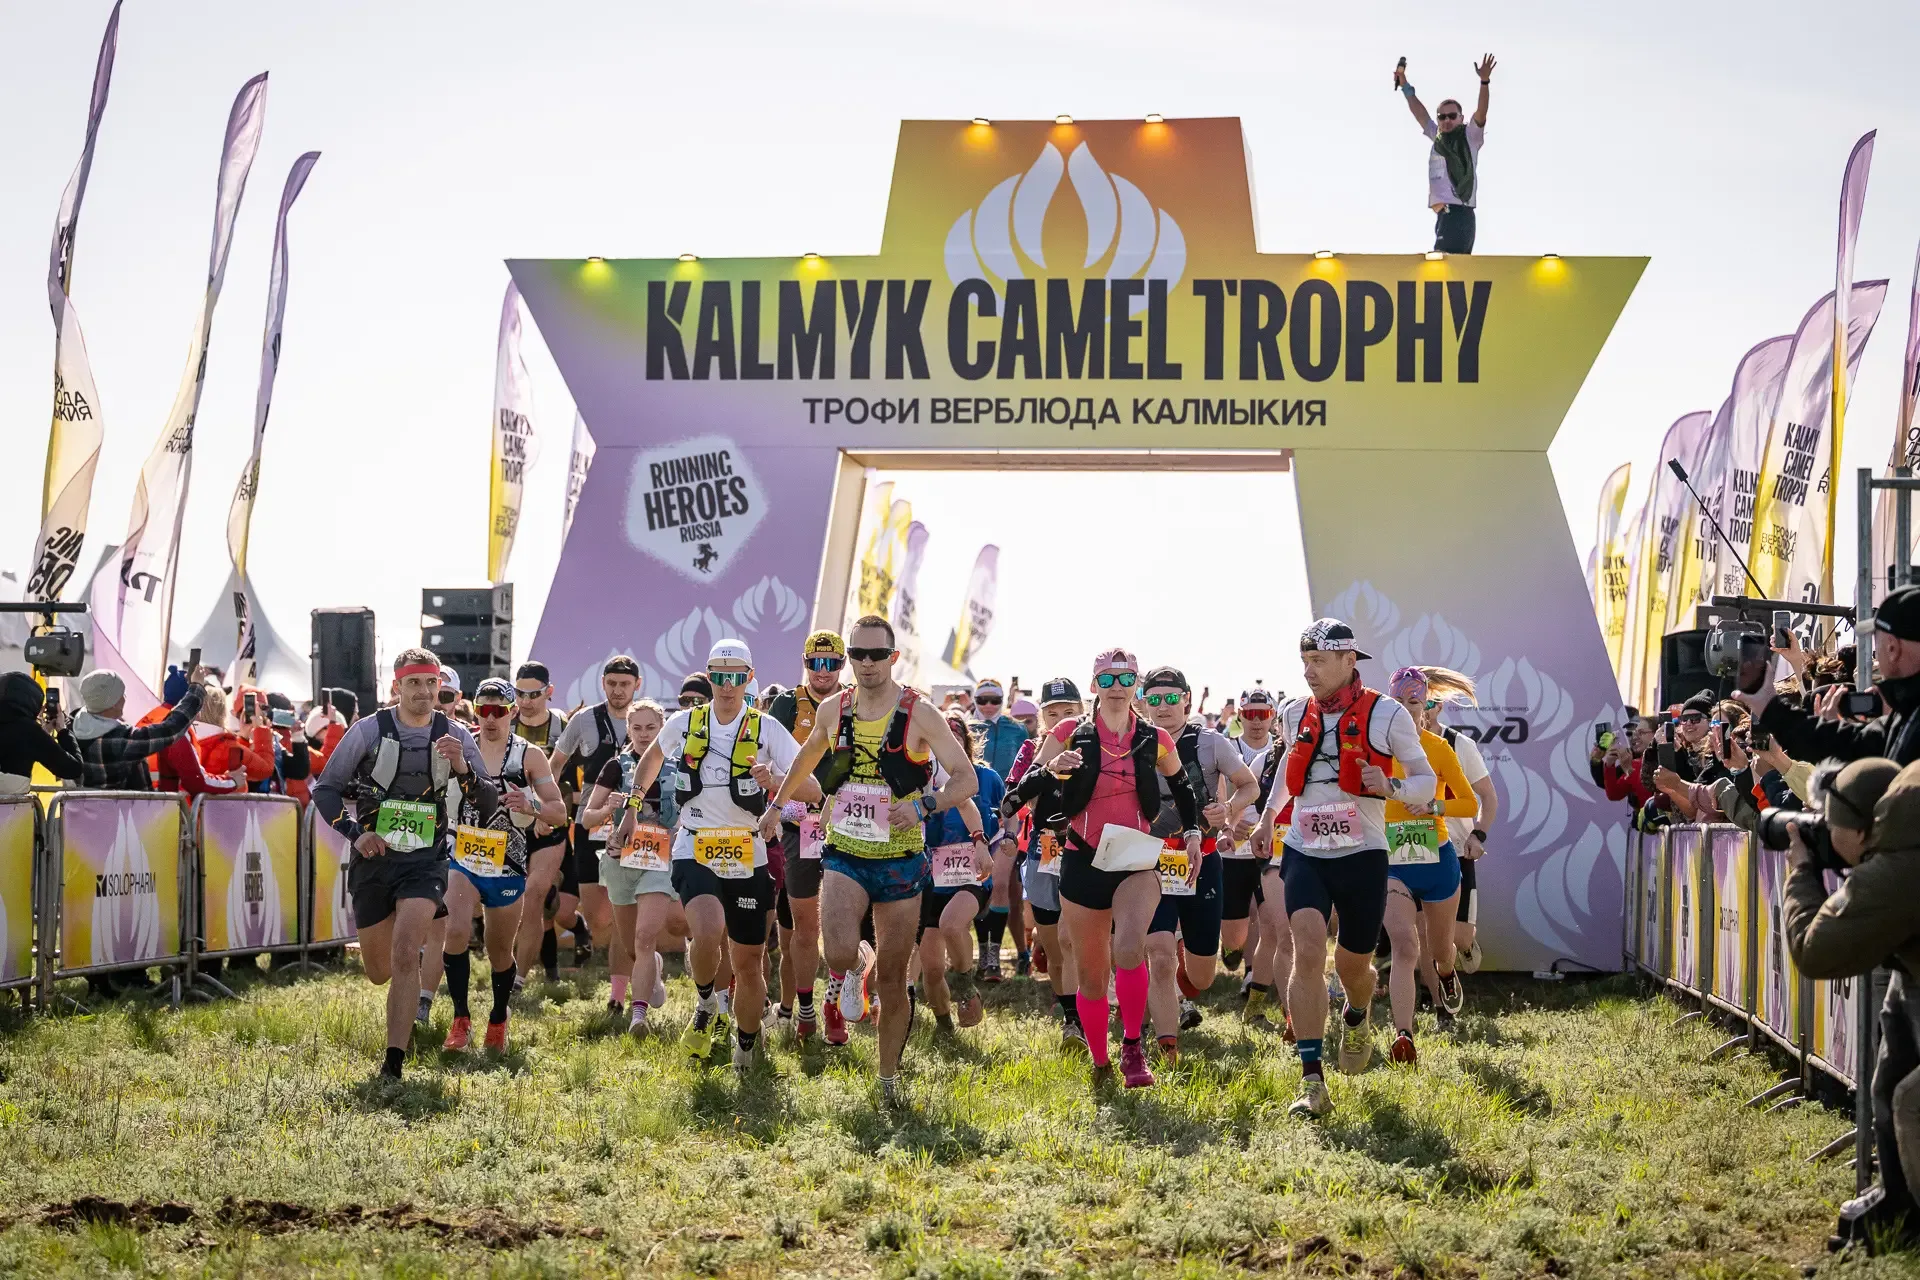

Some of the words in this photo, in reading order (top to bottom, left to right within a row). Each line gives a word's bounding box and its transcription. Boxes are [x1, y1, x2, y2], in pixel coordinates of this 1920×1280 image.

[646, 279, 932, 381] KALMYK
[947, 278, 1183, 381] CAMEL
[1193, 279, 1492, 383] TROPHY
[803, 397, 919, 424] ТРОФИ
[931, 397, 1121, 430] ВЕРБЛЮДА
[1133, 399, 1327, 425] КАЛМЫКИЯ
[1783, 422, 1820, 454] KALMY
[650, 450, 733, 490] RUNNING
[1733, 468, 1759, 495] KALM
[1772, 475, 1809, 507] TROPH
[643, 476, 749, 532] HEROES
[679, 520, 723, 543] RUSSIA
[1729, 518, 1753, 544] TROP
[1731, 564, 1745, 576] ТРО
[843, 802, 875, 820] 4311
[1321, 813, 1334, 821] S40
[388, 817, 424, 834] 2391
[1311, 820, 1351, 836] 4345
[809, 829, 826, 841] 43
[1395, 832, 1427, 846] 2401
[463, 841, 496, 859] 8254
[633, 838, 660, 853] 6194
[705, 845, 743, 860] 8256
[943, 856, 971, 868] 4172
[1160, 863, 1187, 877] 260
[108, 872, 156, 897] SOLOPHARM
